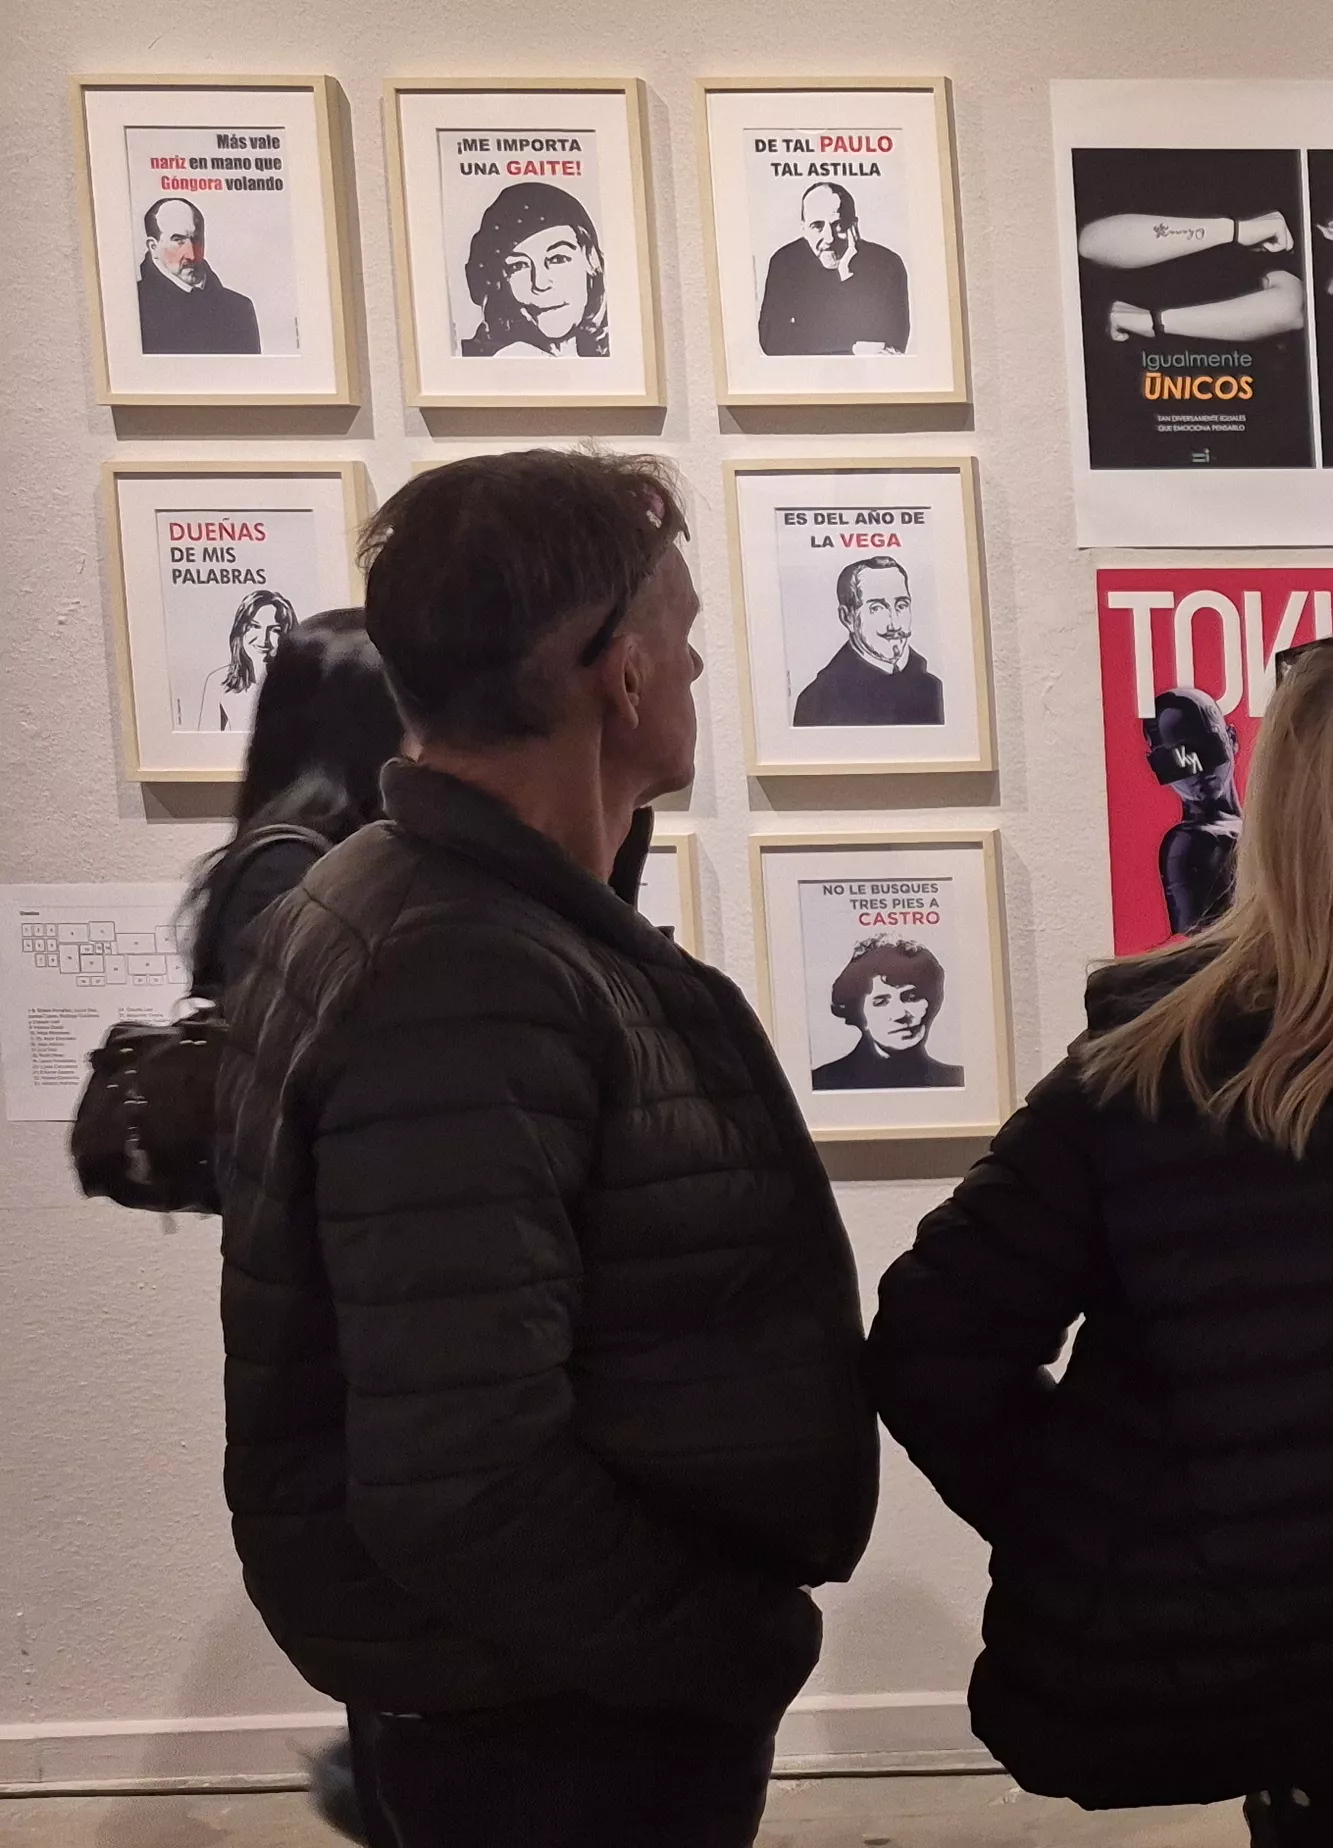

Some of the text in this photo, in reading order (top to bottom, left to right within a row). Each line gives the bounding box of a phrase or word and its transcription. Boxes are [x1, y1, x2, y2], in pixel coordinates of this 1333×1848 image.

[216, 134, 281, 150] Más vale
[457, 138, 582, 155] ¡ME IMPORTA
[755, 135, 893, 153] DE TAL PAULO
[150, 155, 282, 172] nariz en mano que
[460, 160, 582, 176] UNA GAITE!
[771, 162, 881, 176] TAL ASTILLA
[161, 175, 283, 191] Góngora volando
[1142, 350, 1253, 371] Igualmente
[784, 509, 925, 526] ES DEL AÑO DE
[169, 517, 266, 541] DUEÑAS
[811, 533, 902, 548] LA VEGA
[170, 547, 236, 563] DE MIS
[171, 568, 267, 584] PALABRAS
[823, 883, 939, 896] NO LE BUSQUES
[850, 898, 940, 910] TRES PIES A
[858, 912, 940, 926] CASTRO
